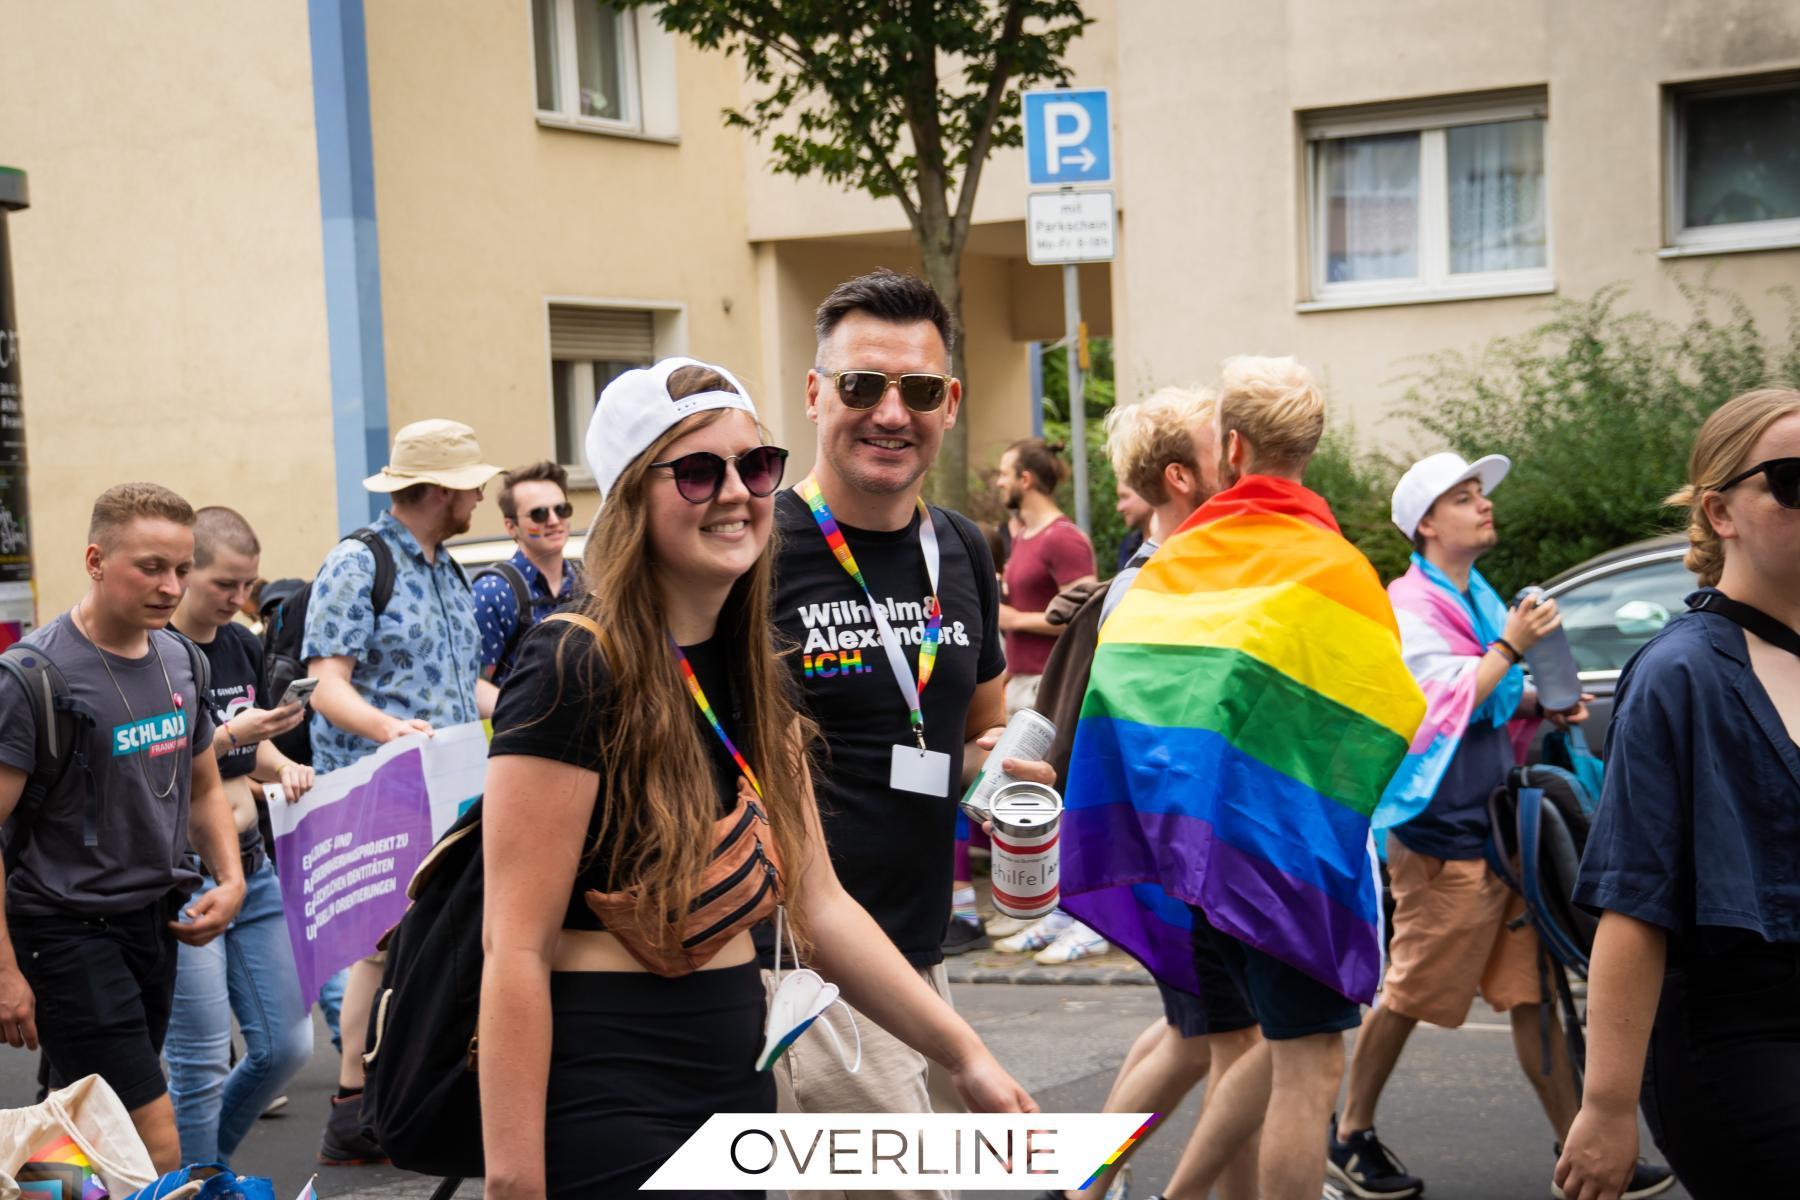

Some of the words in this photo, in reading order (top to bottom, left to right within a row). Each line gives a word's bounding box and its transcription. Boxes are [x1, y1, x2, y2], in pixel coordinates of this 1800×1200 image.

[1043, 102, 1092, 175] P
[803, 649, 872, 679] ICH.
[217, 684, 244, 696] GENDER
[117, 716, 185, 751] SCHLAU
[395, 832, 408, 849] ZU
